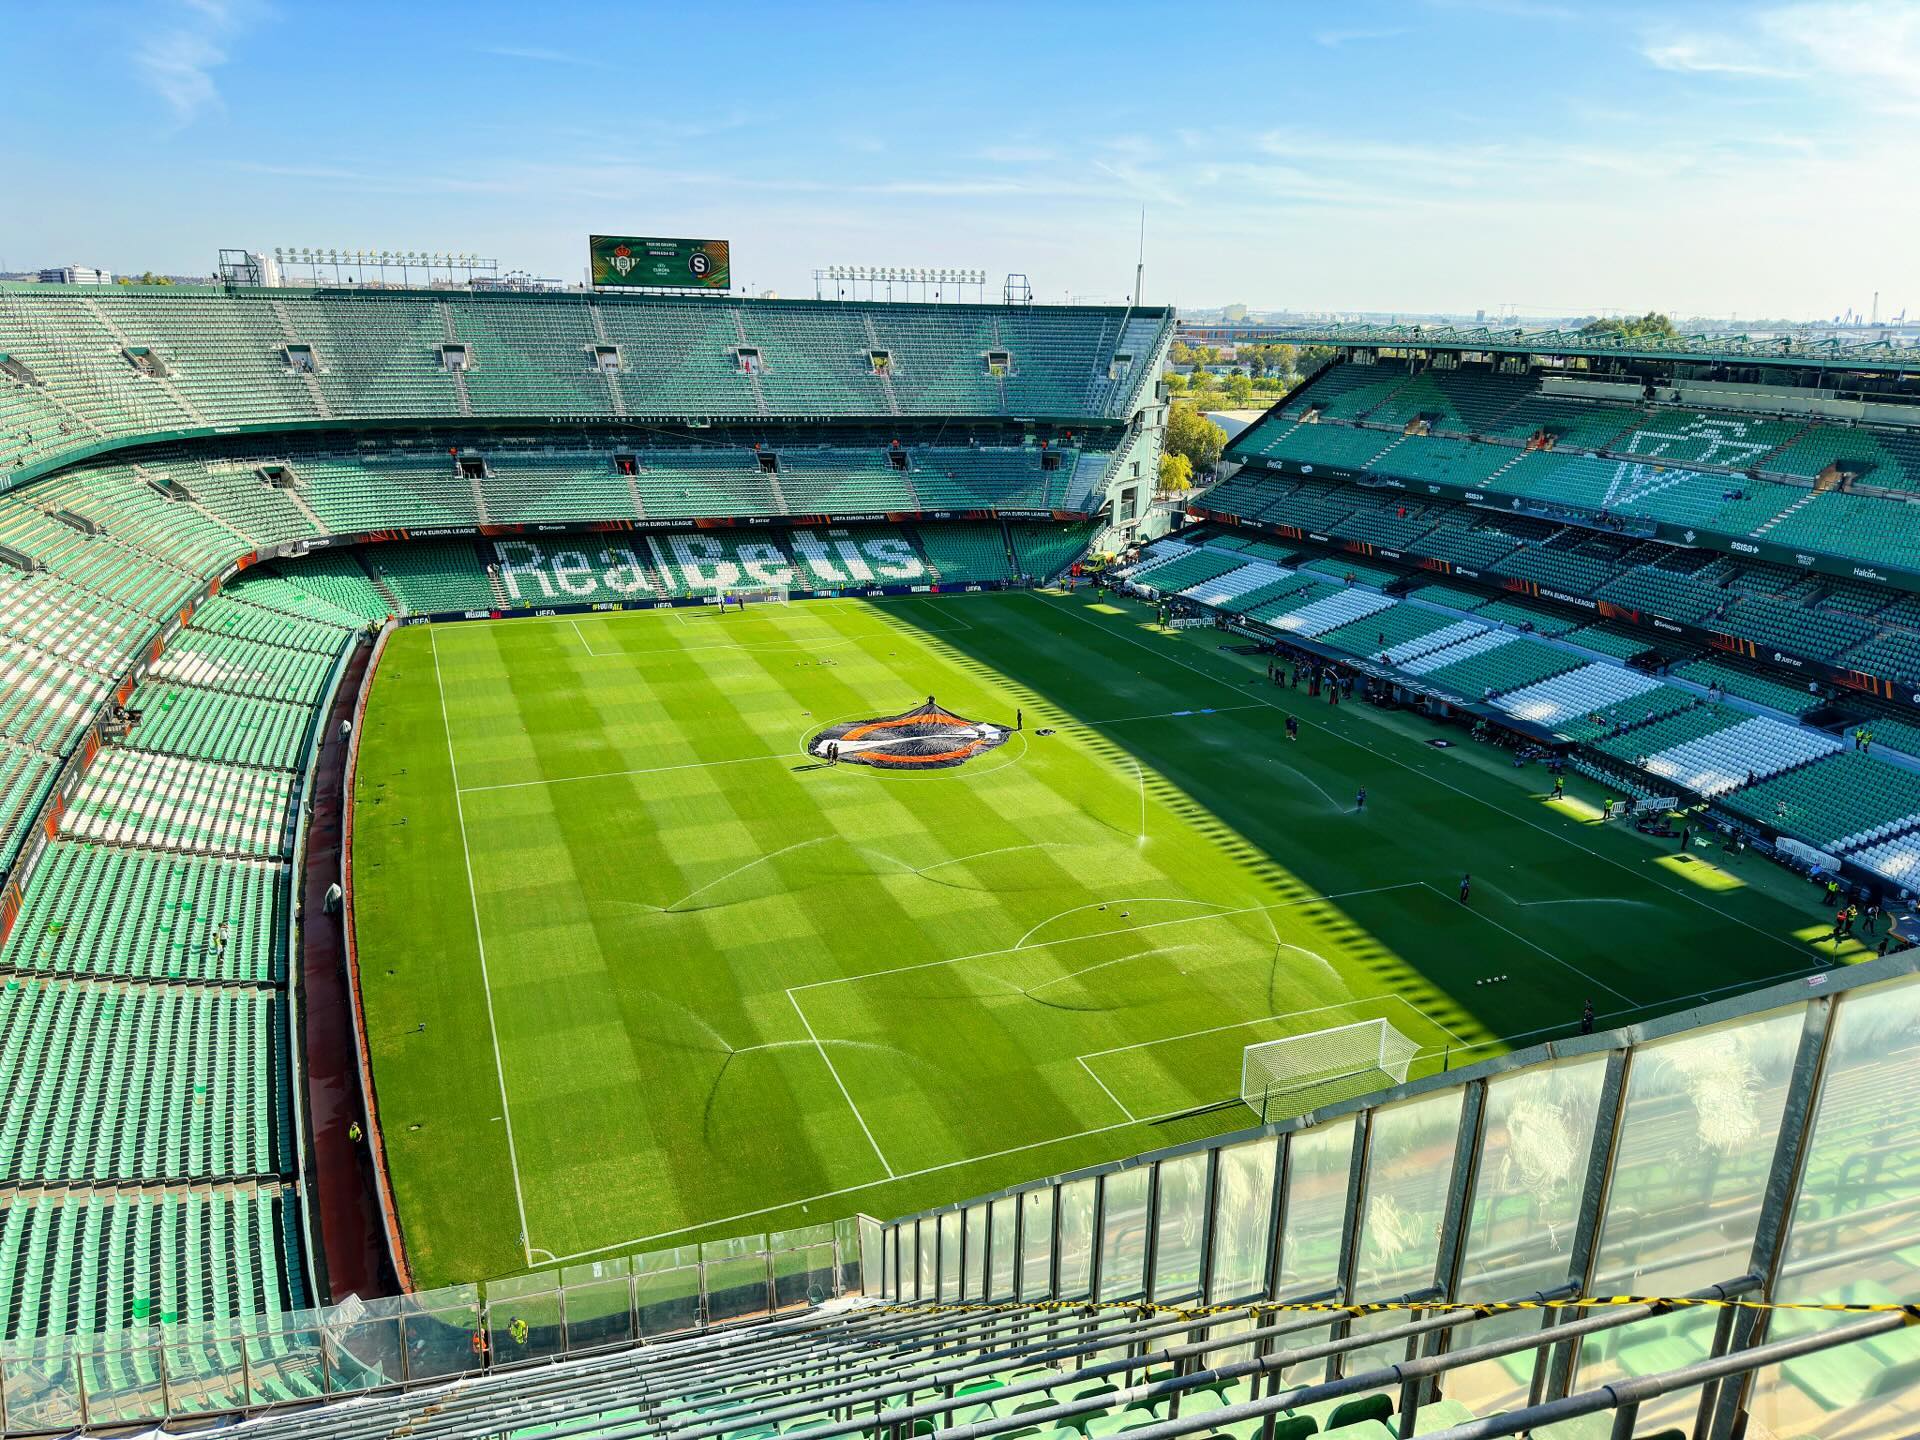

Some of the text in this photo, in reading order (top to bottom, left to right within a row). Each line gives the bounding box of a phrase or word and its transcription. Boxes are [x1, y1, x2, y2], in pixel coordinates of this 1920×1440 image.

[1731, 541, 1752, 553] asisa
[1540, 588, 1596, 608] UEFA EUROPA LEAGUE
